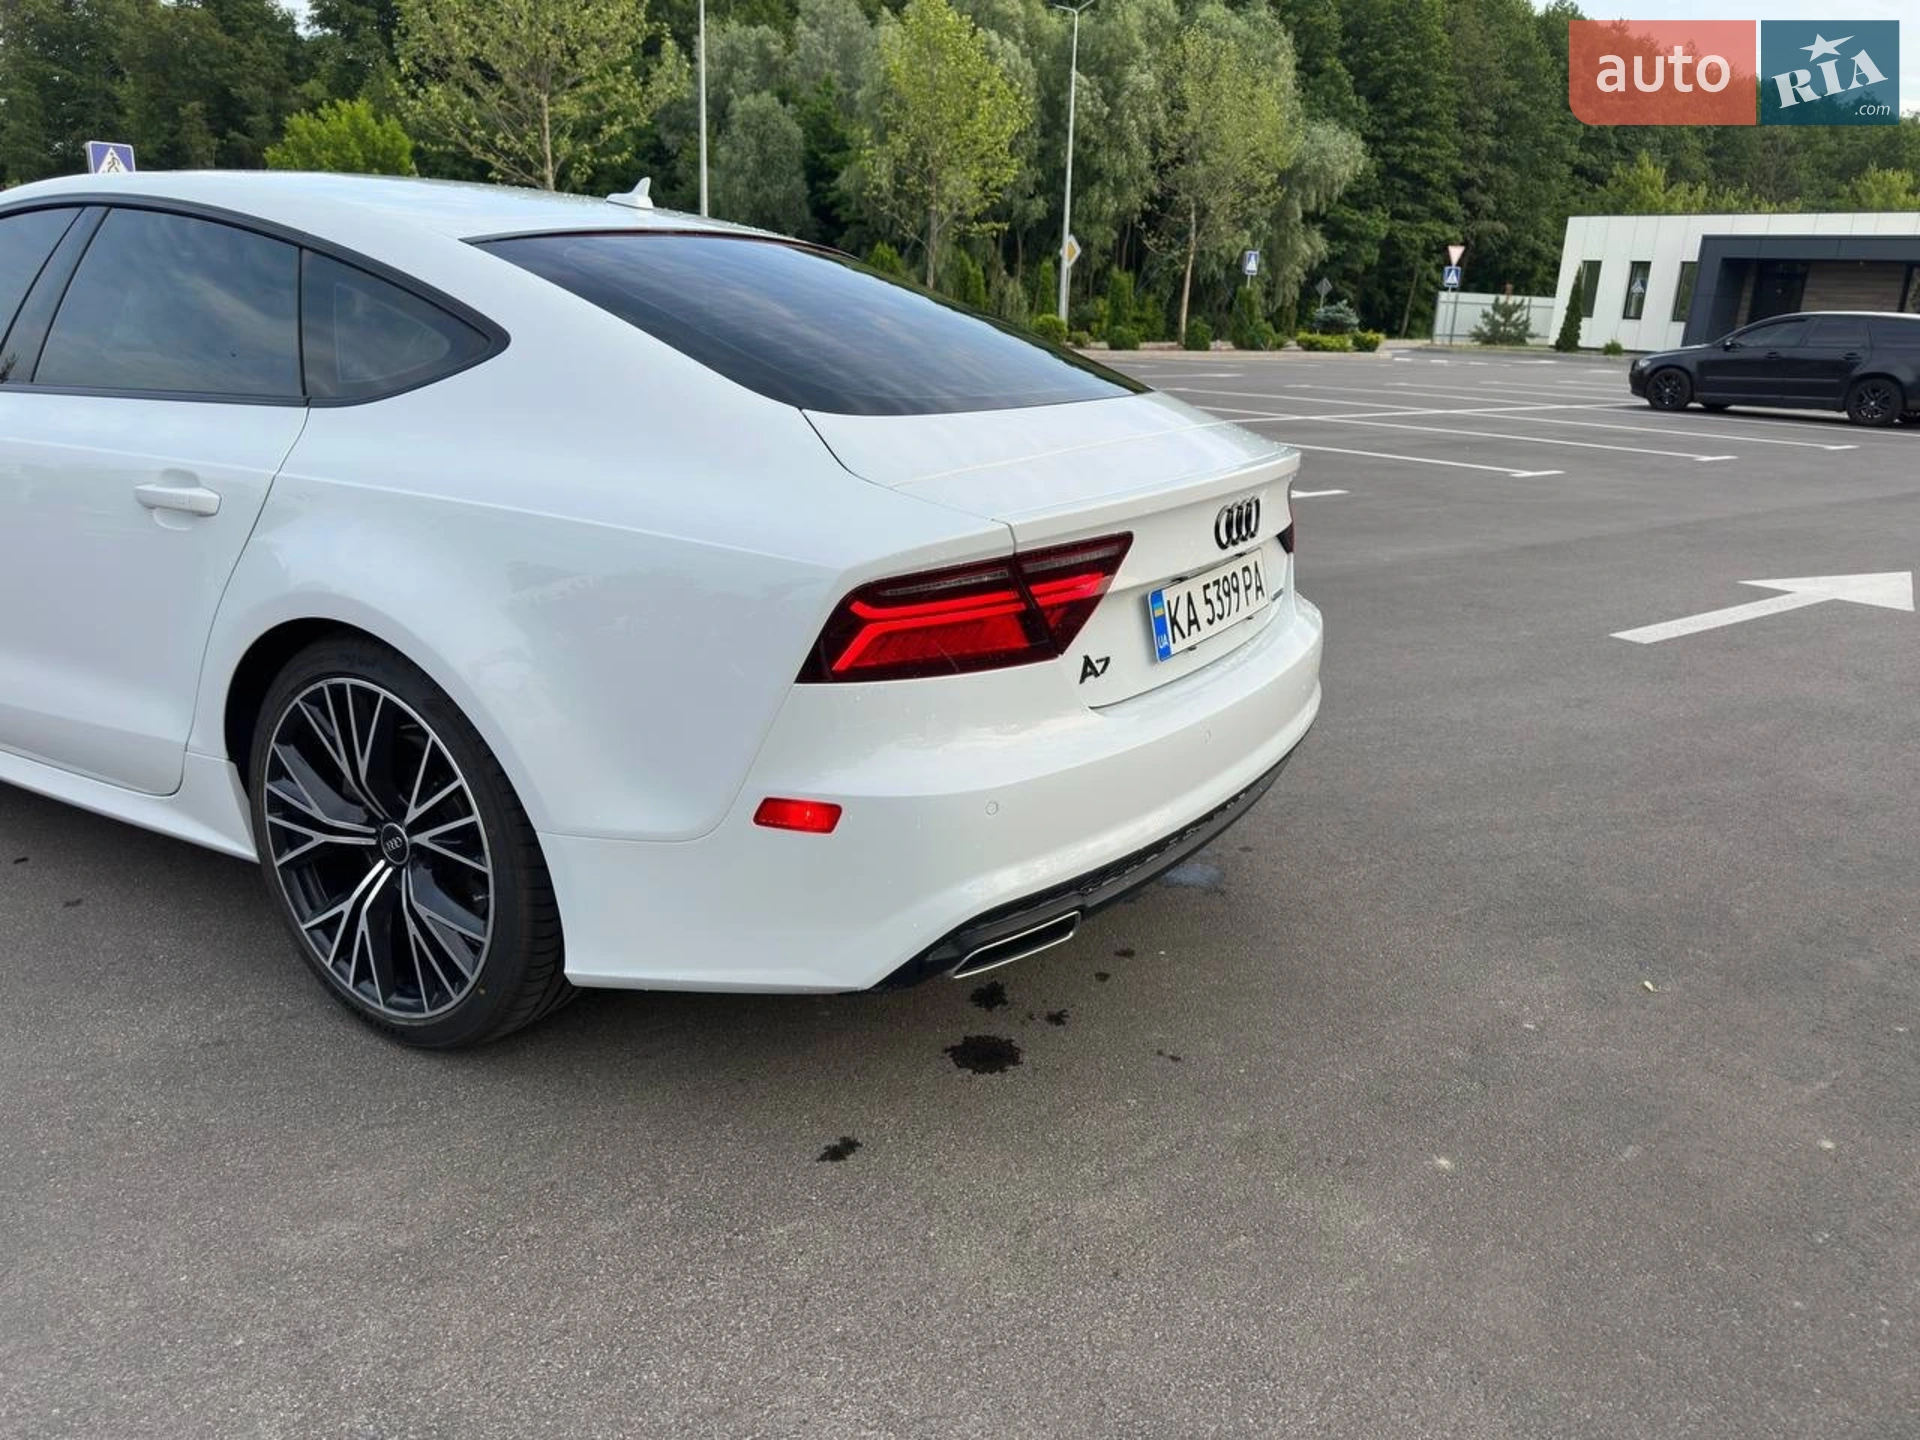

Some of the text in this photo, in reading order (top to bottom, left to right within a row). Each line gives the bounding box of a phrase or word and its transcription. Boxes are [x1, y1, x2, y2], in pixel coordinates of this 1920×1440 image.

[1167, 561, 1265, 644] KA 5399 PA
[1157, 634, 1169, 649] UA
[1079, 655, 1110, 684] A7
